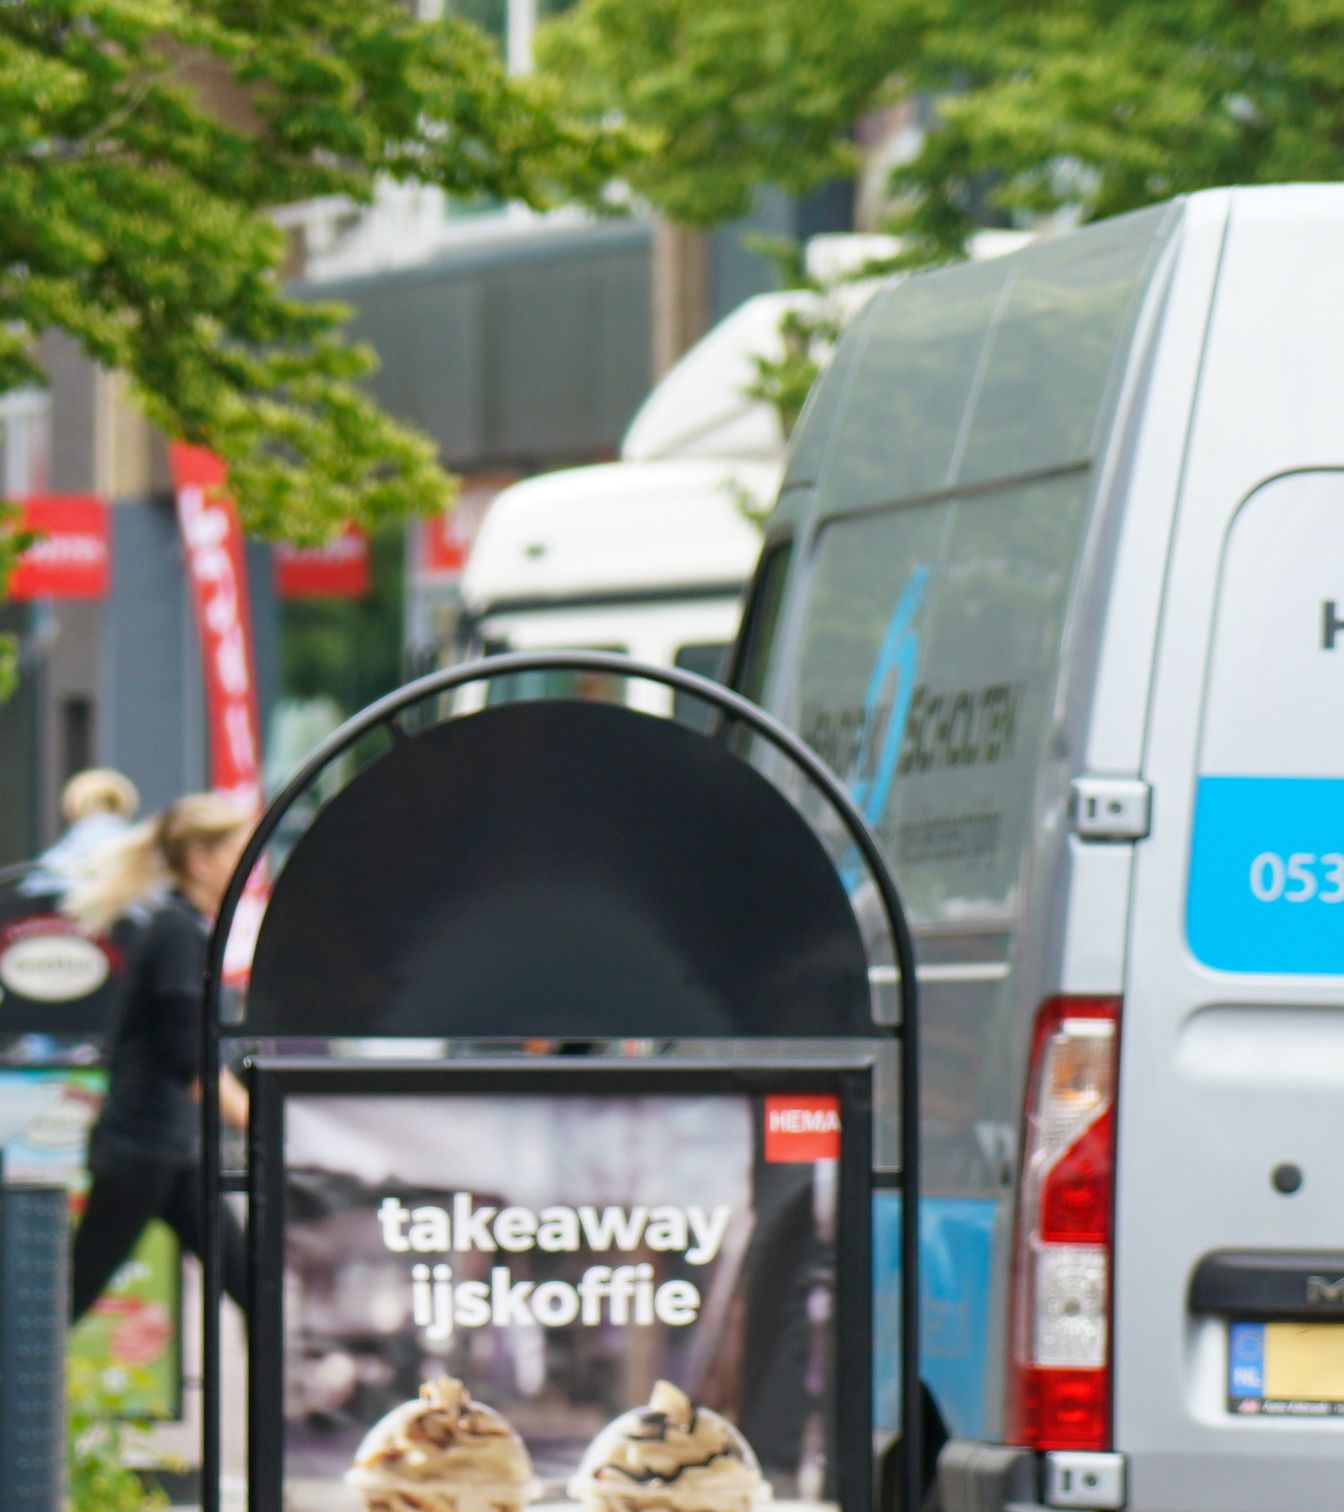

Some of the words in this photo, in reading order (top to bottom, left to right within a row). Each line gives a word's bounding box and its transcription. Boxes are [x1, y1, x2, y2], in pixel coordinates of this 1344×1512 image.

[769, 1109, 842, 1133] HEMA
[376, 1191, 731, 1265] takeaway
[411, 1262, 702, 1341] ijskoffie
[1233, 1367, 1262, 1388] NL
